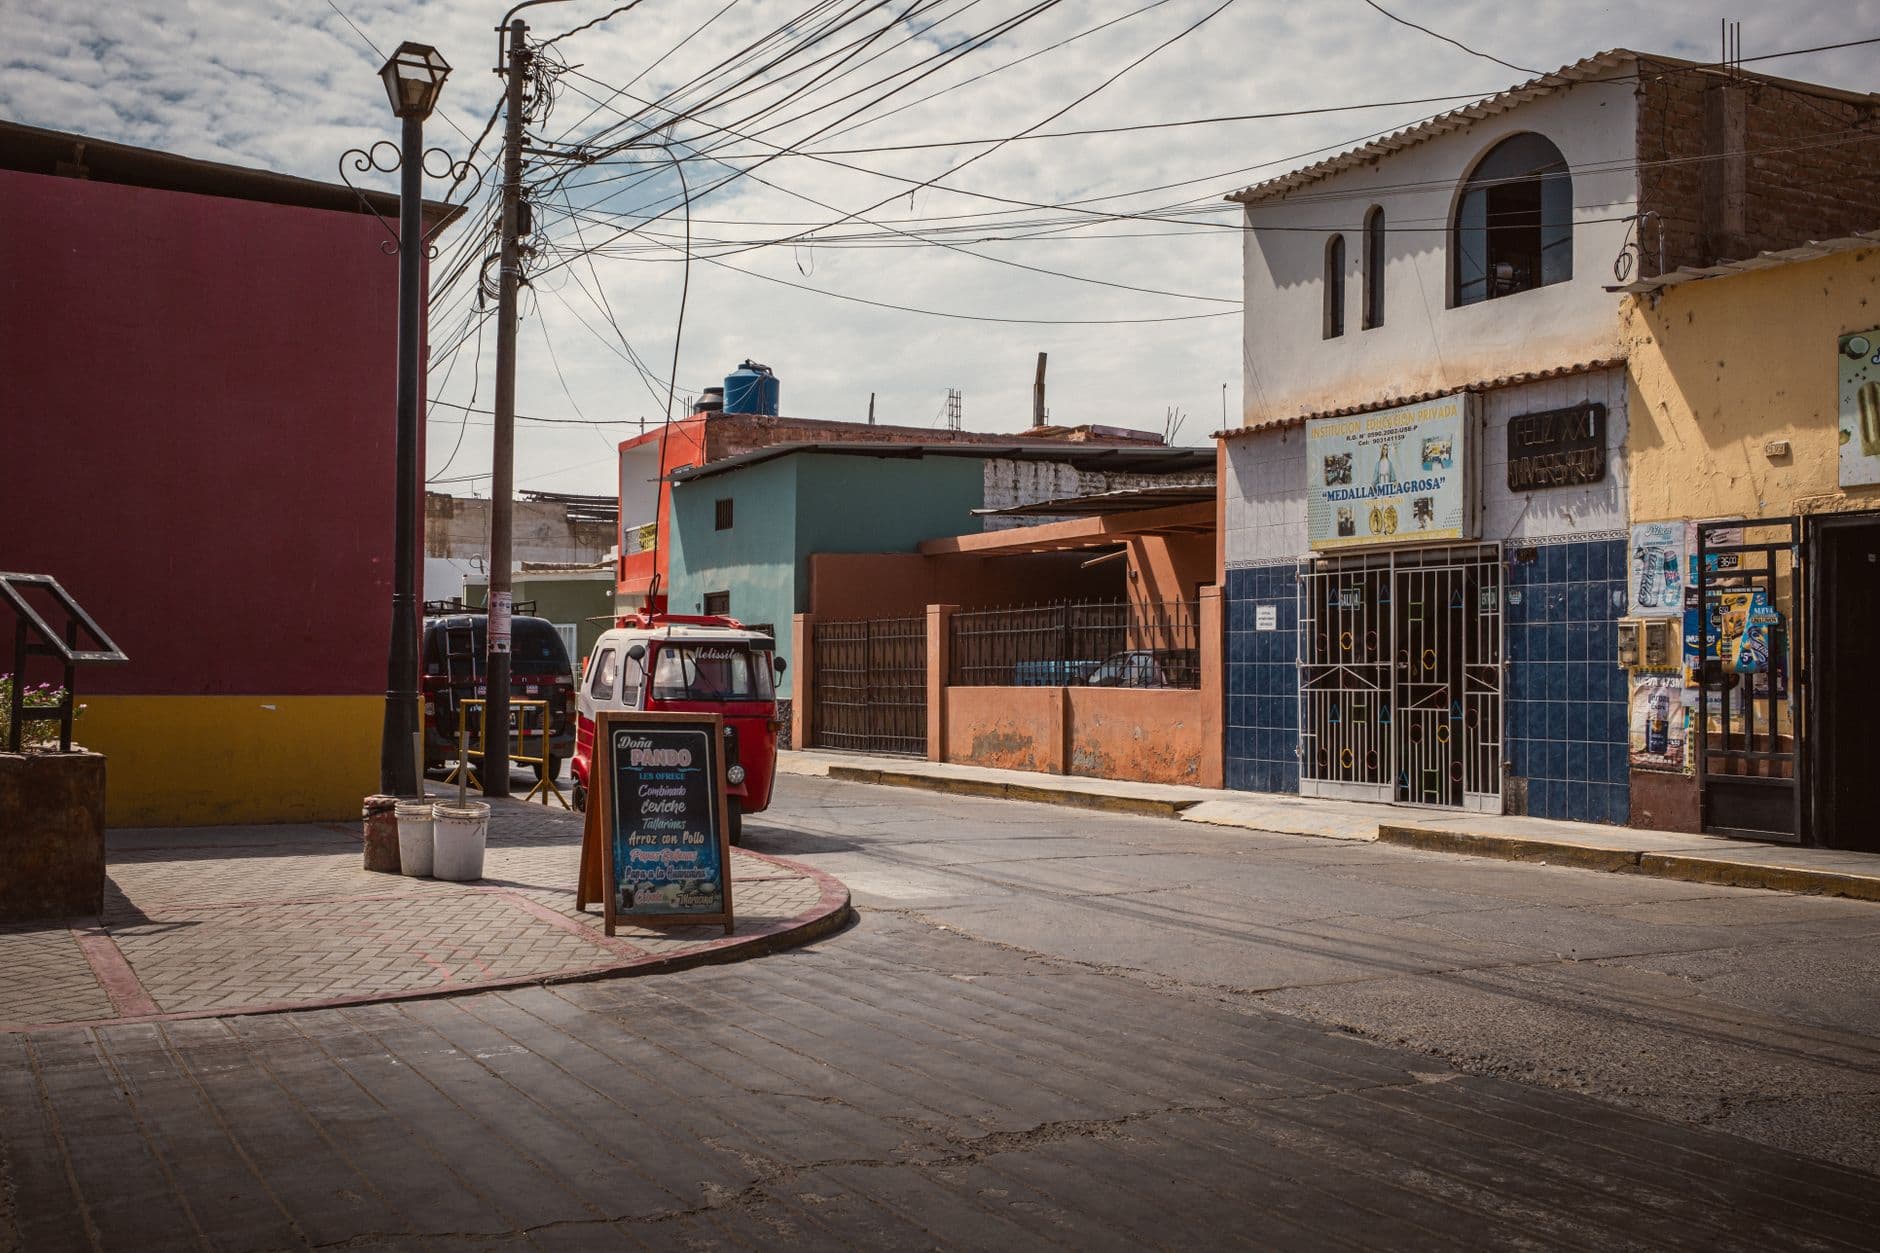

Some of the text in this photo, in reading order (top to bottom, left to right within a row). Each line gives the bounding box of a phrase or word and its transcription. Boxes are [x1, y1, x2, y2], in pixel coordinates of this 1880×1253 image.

[1418, 404, 1458, 423] PRIVADA
[618, 736, 652, 749] Doña
[631, 748, 692, 767] PANDO
[655, 772, 685, 780] OFRECE
[638, 784, 687, 797] Combinado
[641, 799, 686, 815] Ceviche
[642, 817, 686, 830] Tallarines
[629, 830, 705, 846] Arroz con Pollo
